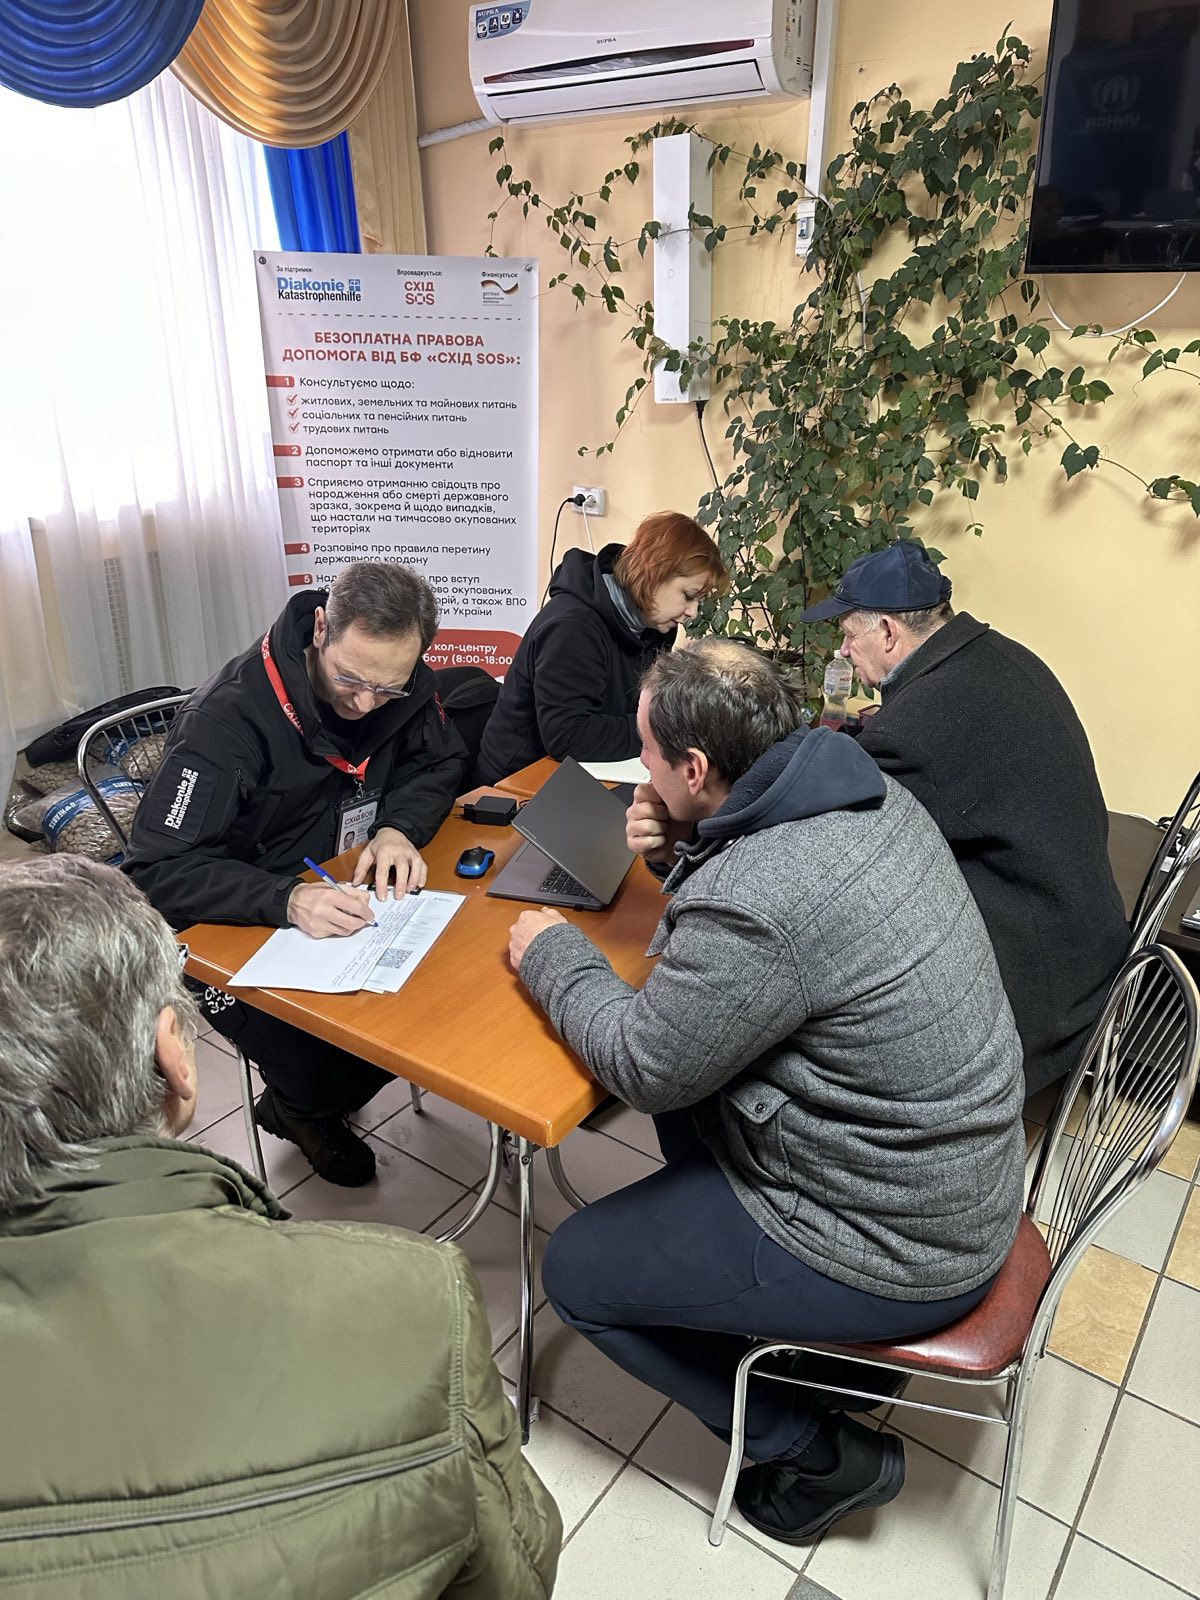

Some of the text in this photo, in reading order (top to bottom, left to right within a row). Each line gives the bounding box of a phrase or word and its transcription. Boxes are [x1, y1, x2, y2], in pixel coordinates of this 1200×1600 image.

[397, 269, 443, 277] Впроваджується:
[277, 277, 344, 292] Diakonie
[404, 281, 435, 292] СХІД
[278, 290, 361, 302] Katastrophenhilfe
[406, 293, 435, 305] SOS
[314, 332, 484, 346] БЕЗОПЛАТНА ПРАВОВА
[282, 349, 521, 366] ДОПОМОГА ВІД БФ «СХІД SOS»:
[284, 378, 415, 390] 1 Консультуємо щодо:
[301, 398, 355, 407] житлових,
[358, 399, 412, 407] земельних
[430, 398, 479, 408] майнових
[482, 401, 517, 409] питань
[302, 411, 360, 420] соціальних
[378, 412, 429, 422] пенсійних
[432, 414, 467, 422] питань
[303, 425, 389, 435] трудових питань
[291, 446, 513, 459] 2 Допоможемо отримати або відновити
[306, 459, 353, 469] паспорт
[370, 458, 392, 468] інші
[395, 460, 453, 470] документи
[294, 478, 500, 492] 3 Сприяємо отриманню свідоцтв про
[308, 490, 508, 503] народження або смерті державного
[309, 501, 495, 514] зразка, зокрема й щодо випадків,
[311, 514, 327, 523] що
[330, 514, 375, 522] настали
[394, 515, 452, 523] тимчасово
[454, 515, 516, 526] окупованих
[312, 524, 370, 535] територіях
[300, 543, 491, 556] 4 Розповімо про правила перетину
[315, 556, 428, 566] державного кордону
[304, 575, 310, 583] 5
[429, 576, 480, 585] про вступ
[452, 587, 512, 596] окупованих
[506, 598, 527, 606] ВПО
[453, 607, 492, 617] України
[435, 644, 497, 654] кол-центру
[422, 654, 514, 665] боту (8:00-18:00
[164, 780, 188, 826] Diakonie
